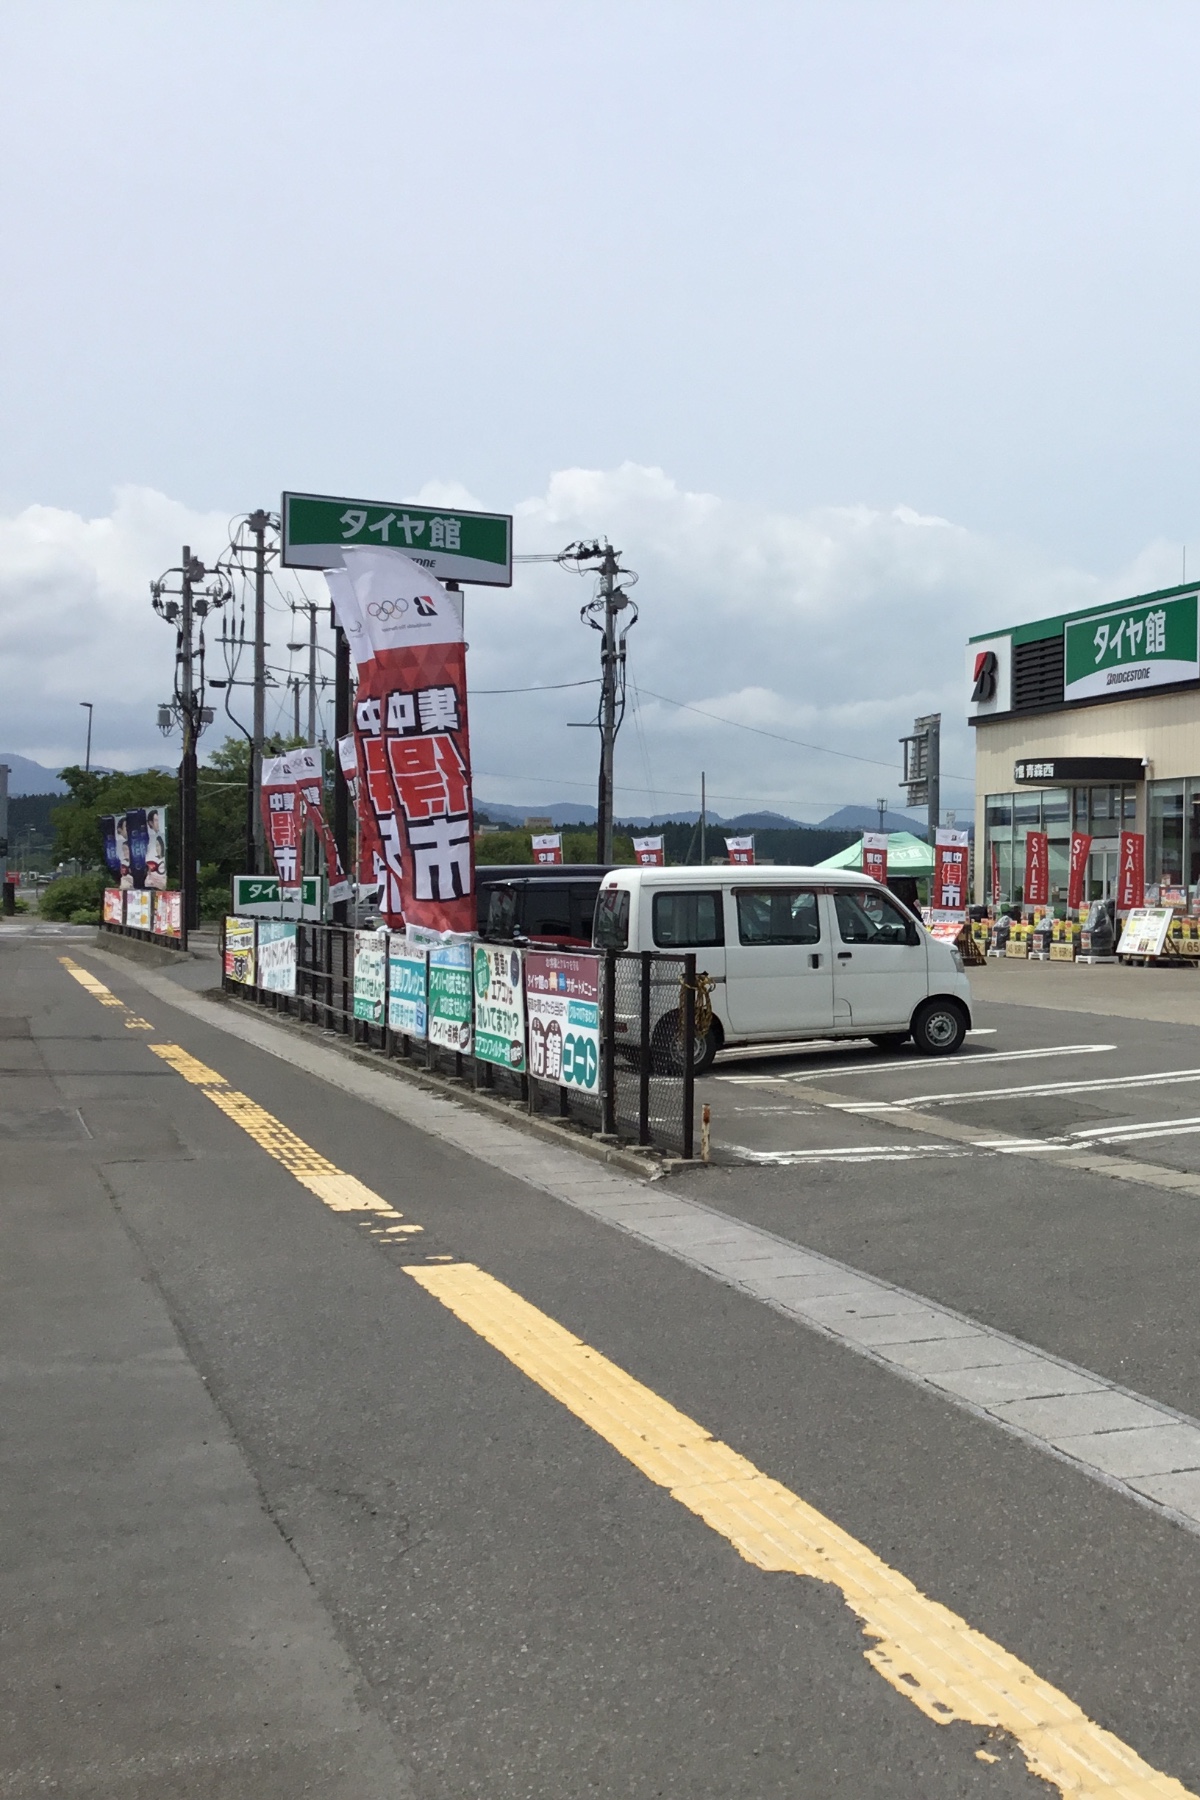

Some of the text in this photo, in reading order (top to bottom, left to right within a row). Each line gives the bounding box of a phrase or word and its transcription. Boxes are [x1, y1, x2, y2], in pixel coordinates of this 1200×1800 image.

[339, 509, 462, 550] タイヤ館
[1093, 609, 1166, 665] タイヤ館
[1106, 667, 1151, 686] BRIDGESTONE
[1029, 837, 1039, 899] SALE
[1123, 838, 1135, 905] SALE
